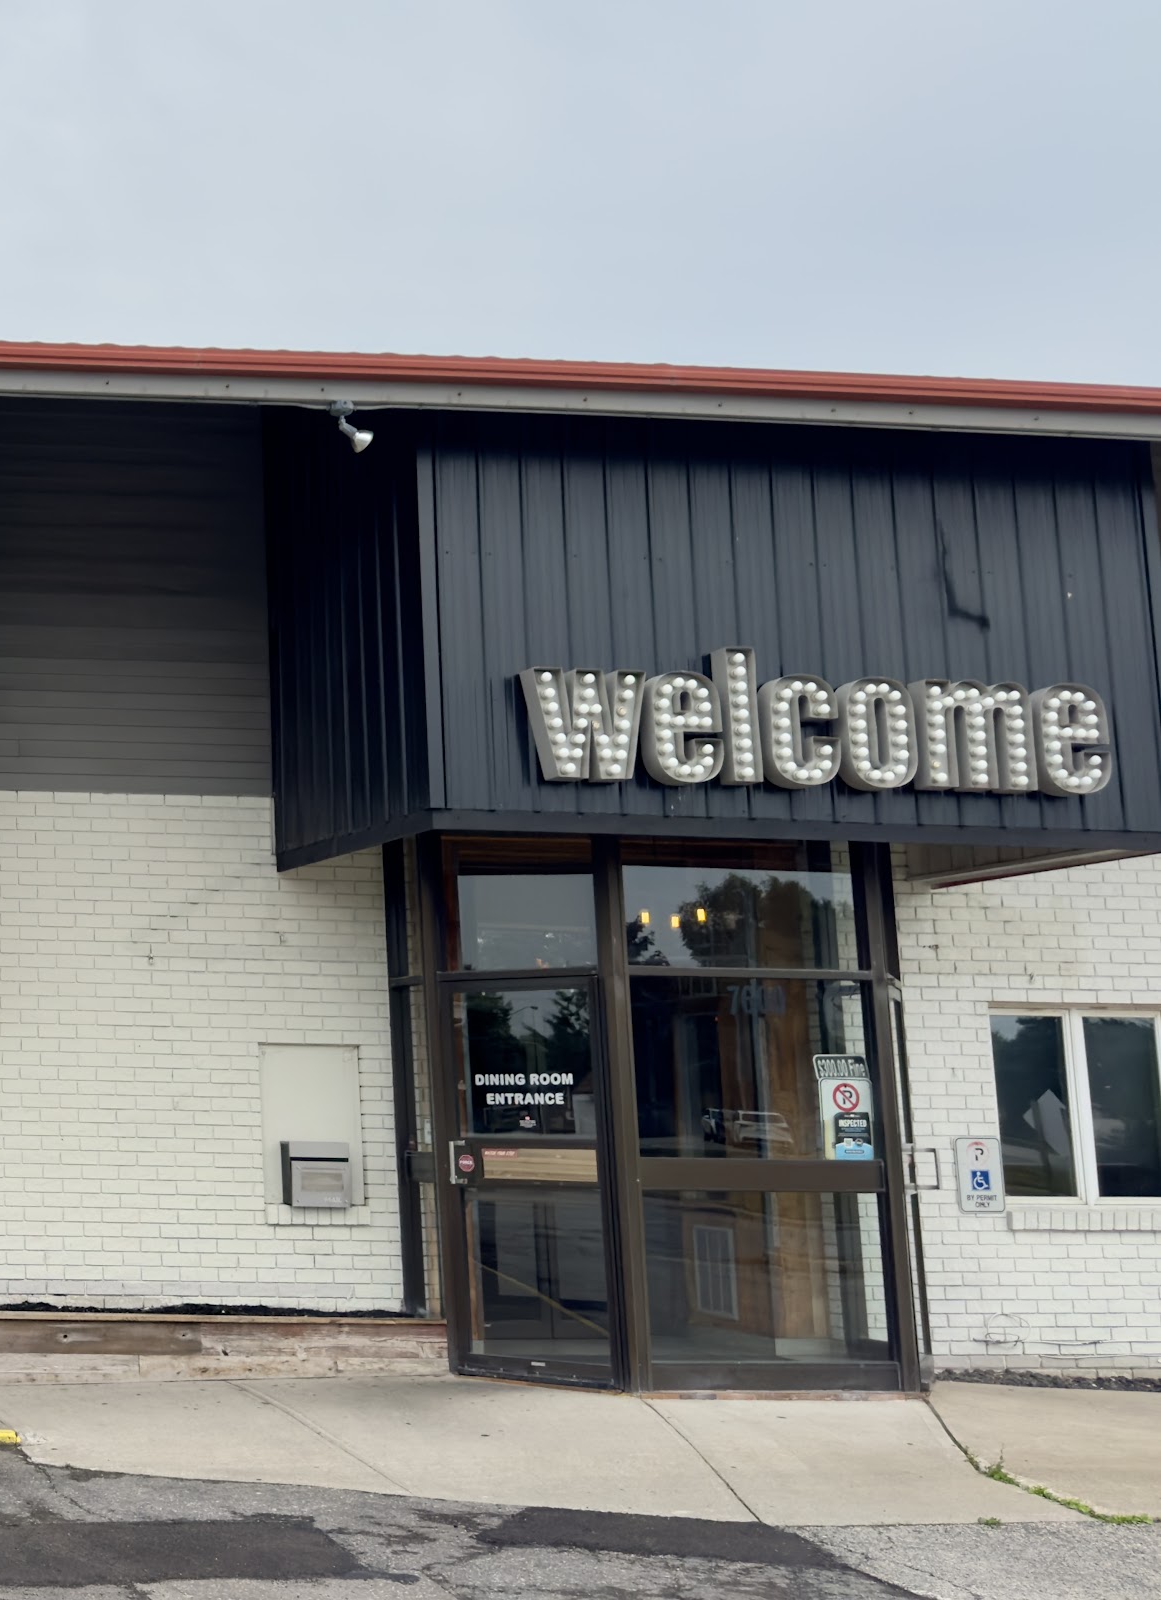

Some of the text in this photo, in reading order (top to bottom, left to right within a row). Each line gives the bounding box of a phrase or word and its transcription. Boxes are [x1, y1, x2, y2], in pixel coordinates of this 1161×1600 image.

[519, 646, 1114, 797] welcome
[818, 1059, 866, 1077] $300.00 Fine
[474, 1073, 574, 1086] DINING ROOM
[486, 1092, 565, 1105] ENTRANCE
[838, 1119, 867, 1128] INSPECTED
